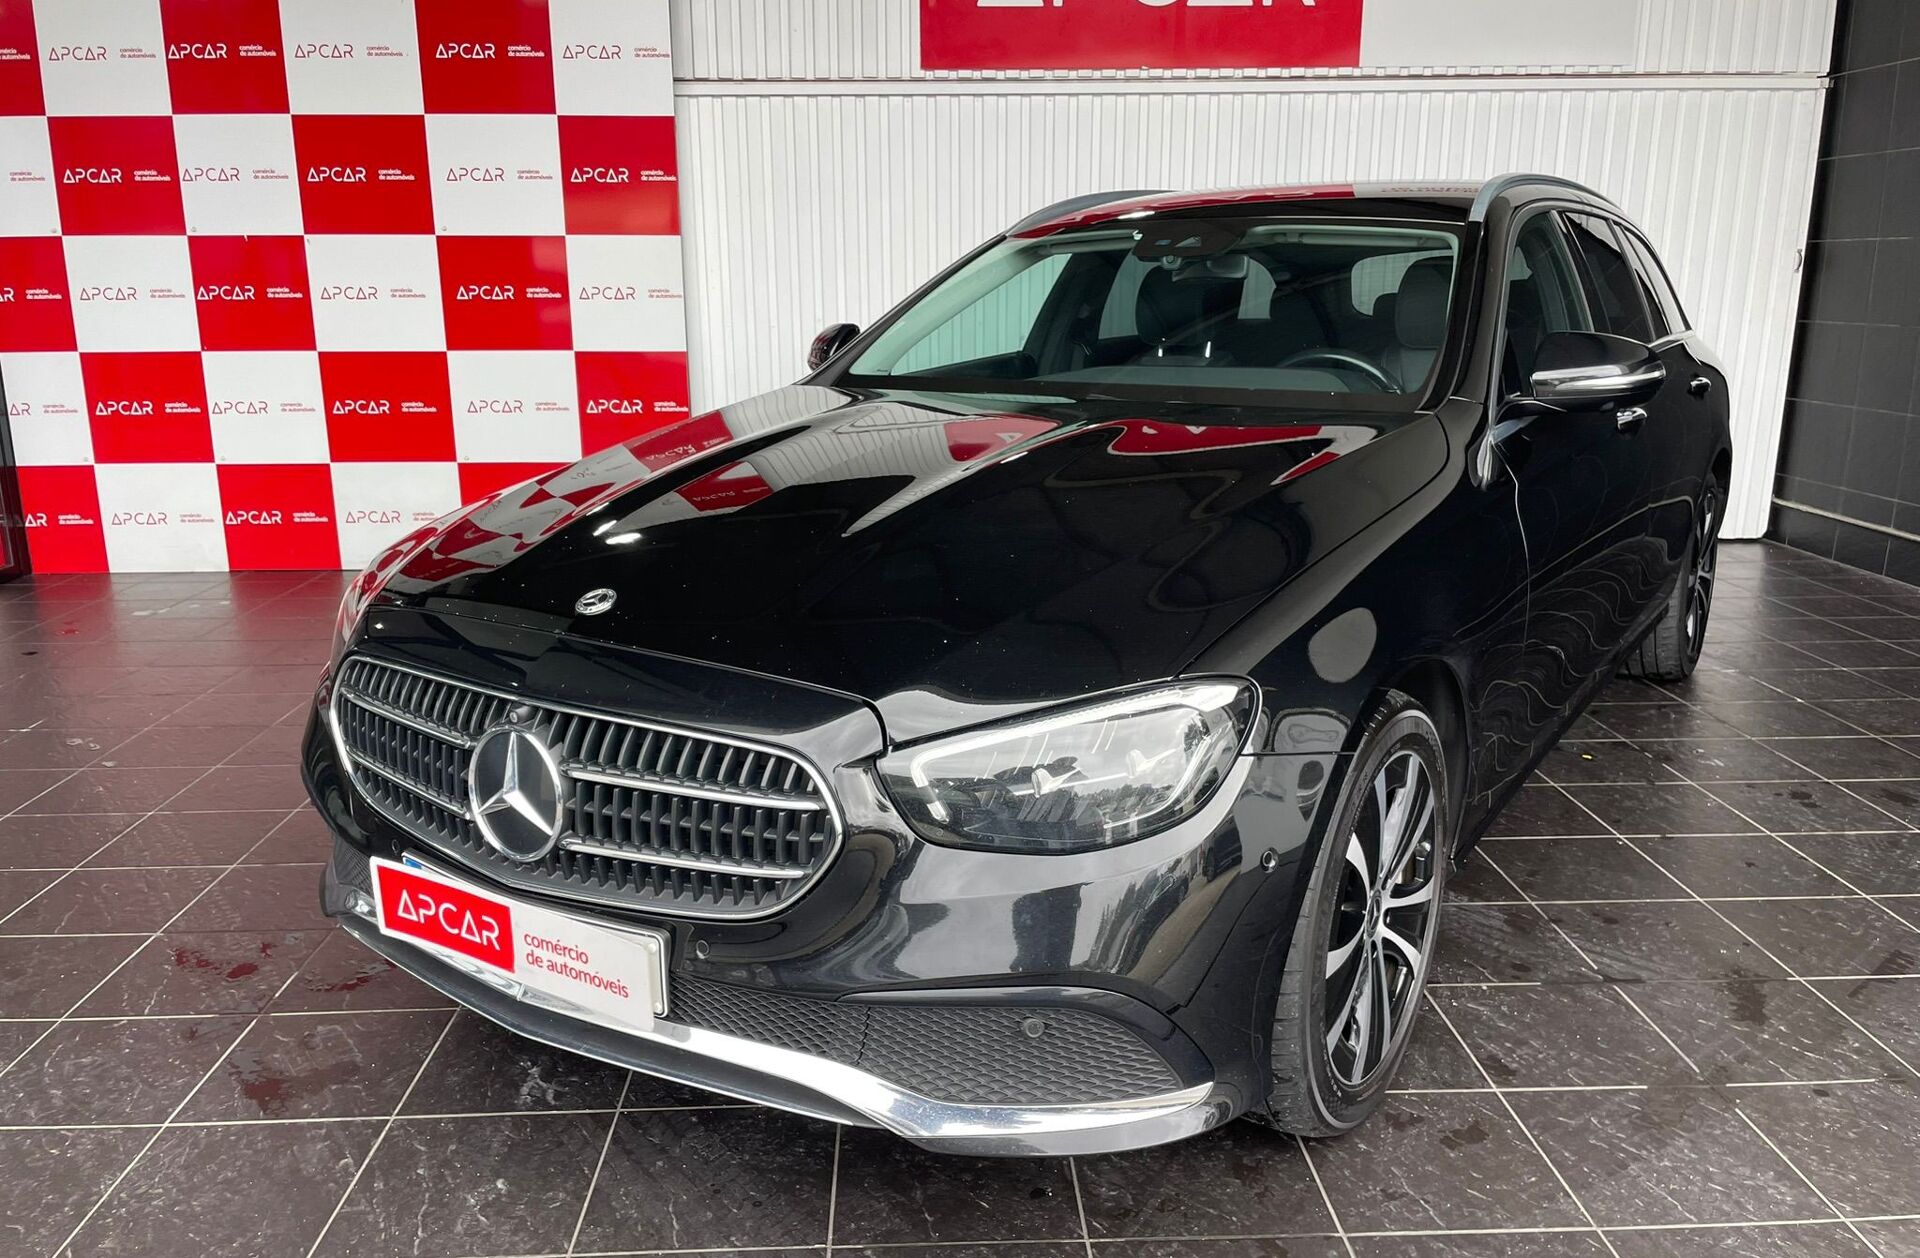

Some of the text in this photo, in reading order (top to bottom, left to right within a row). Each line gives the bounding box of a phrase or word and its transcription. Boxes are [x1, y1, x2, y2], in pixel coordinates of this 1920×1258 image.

[49, 46, 106, 61] APCAR
[168, 44, 227, 59] APCAR
[295, 44, 353, 58] APCAR
[436, 43, 495, 58] APCAR
[563, 45, 621, 59] APCAR
[64, 168, 121, 183] APCAR
[183, 168, 240, 181] APCAR
[307, 167, 366, 182] APCAR
[447, 168, 504, 181] APCAR
[571, 168, 628, 182] APCAR
[80, 287, 136, 300] APCAR
[197, 286, 255, 300] APCAR
[321, 287, 377, 300] APCAR
[457, 286, 514, 300] APCAR
[579, 287, 635, 300] APCAR
[96, 401, 153, 415] APCAR
[212, 401, 268, 414] APCAR
[333, 400, 389, 414] APCAR
[467, 400, 523, 413] APCAR
[586, 400, 642, 413] APCAR
[112, 512, 167, 525] APCAR
[226, 511, 281, 525] APCAR
[346, 511, 400, 523] APCAR
[397, 889, 501, 951] APCAR
[524, 931, 589, 964] comércio
[526, 950, 629, 999] de automóveis
